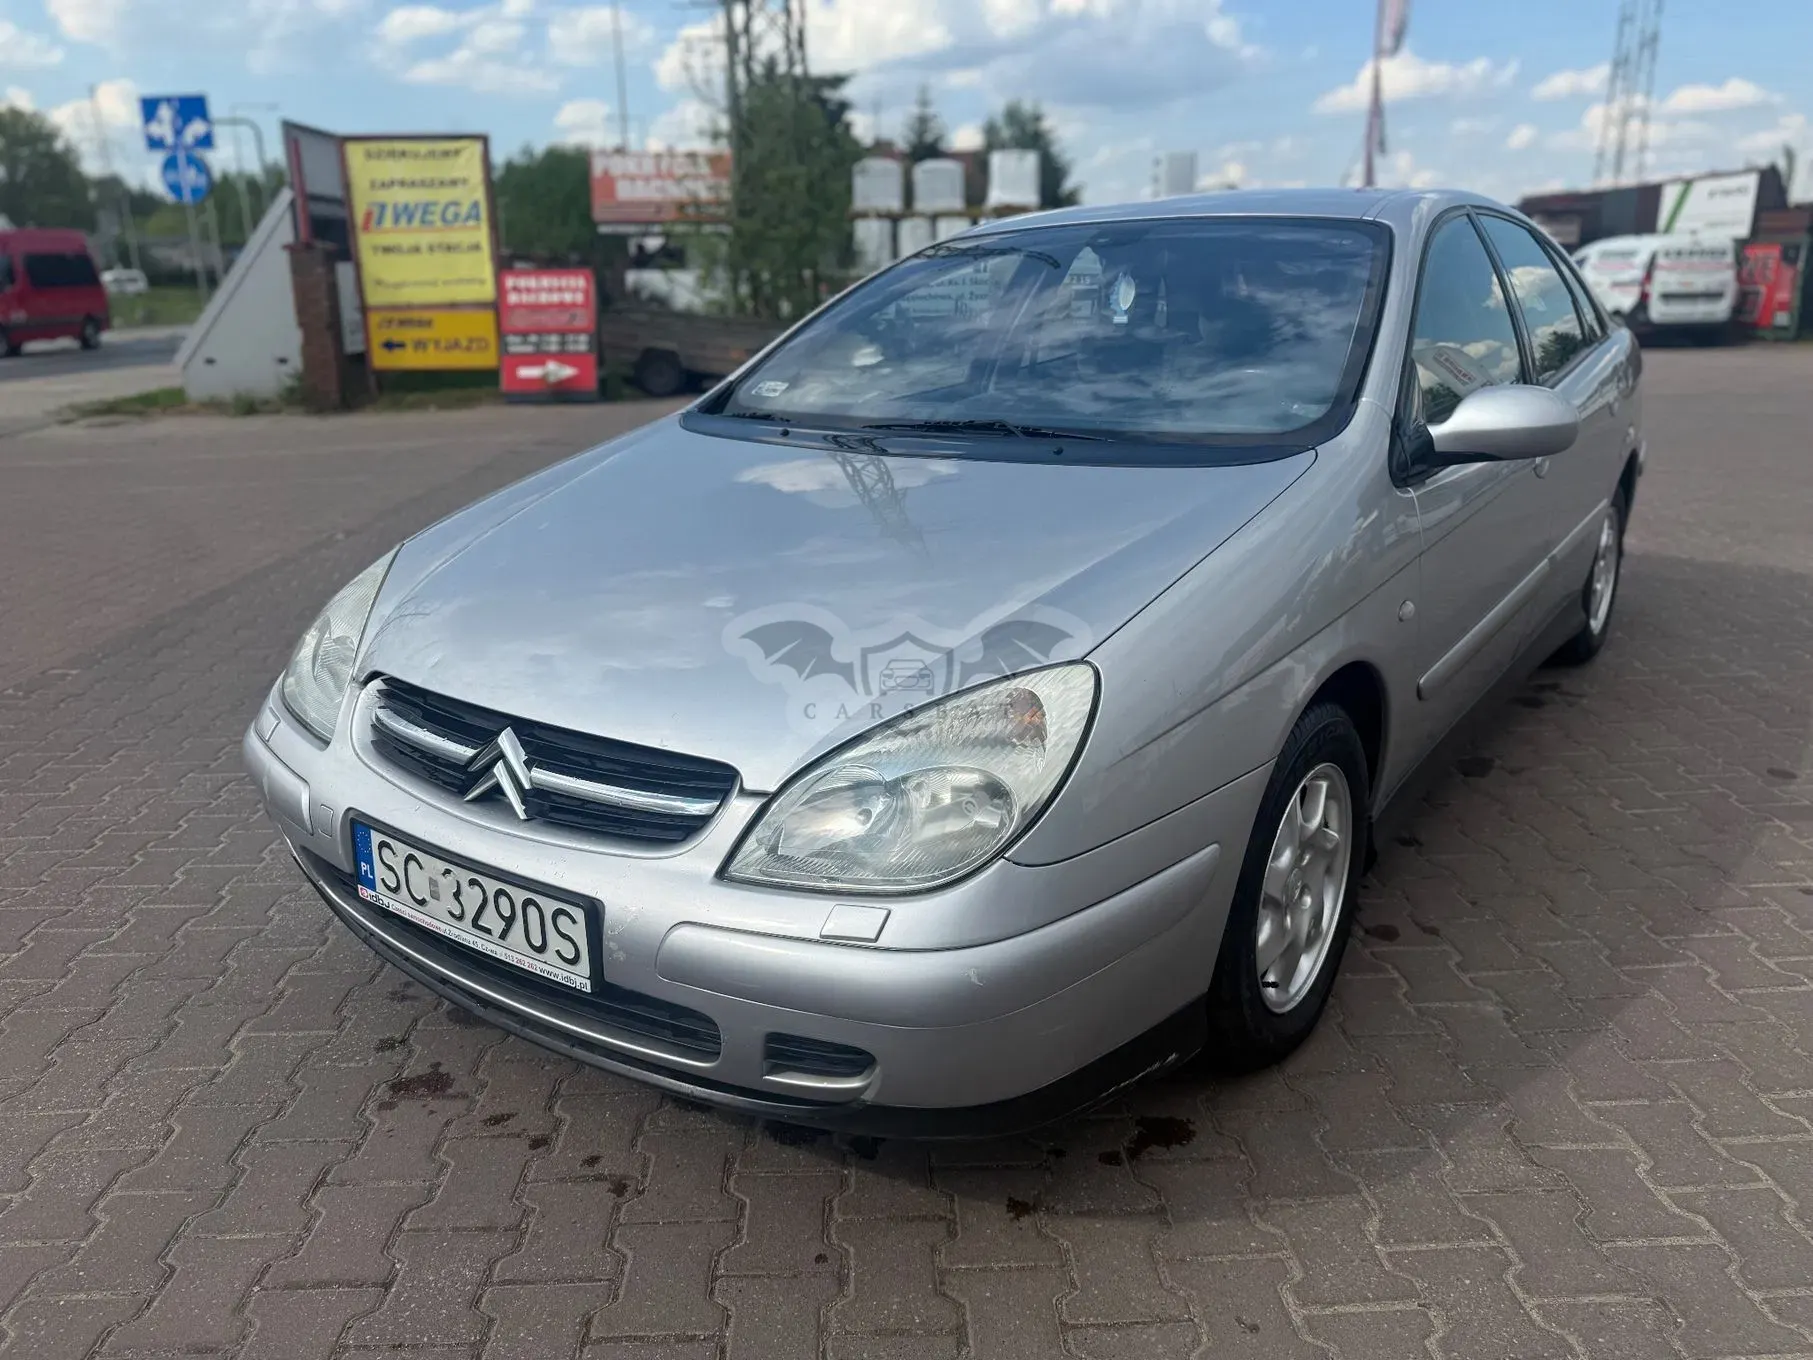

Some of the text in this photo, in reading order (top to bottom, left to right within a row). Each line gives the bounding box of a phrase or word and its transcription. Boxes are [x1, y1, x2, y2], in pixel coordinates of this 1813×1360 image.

[360, 861, 374, 879] PL
[377, 839, 581, 966] SC 3290S
[538, 965, 589, 991] www.idbj.pl
